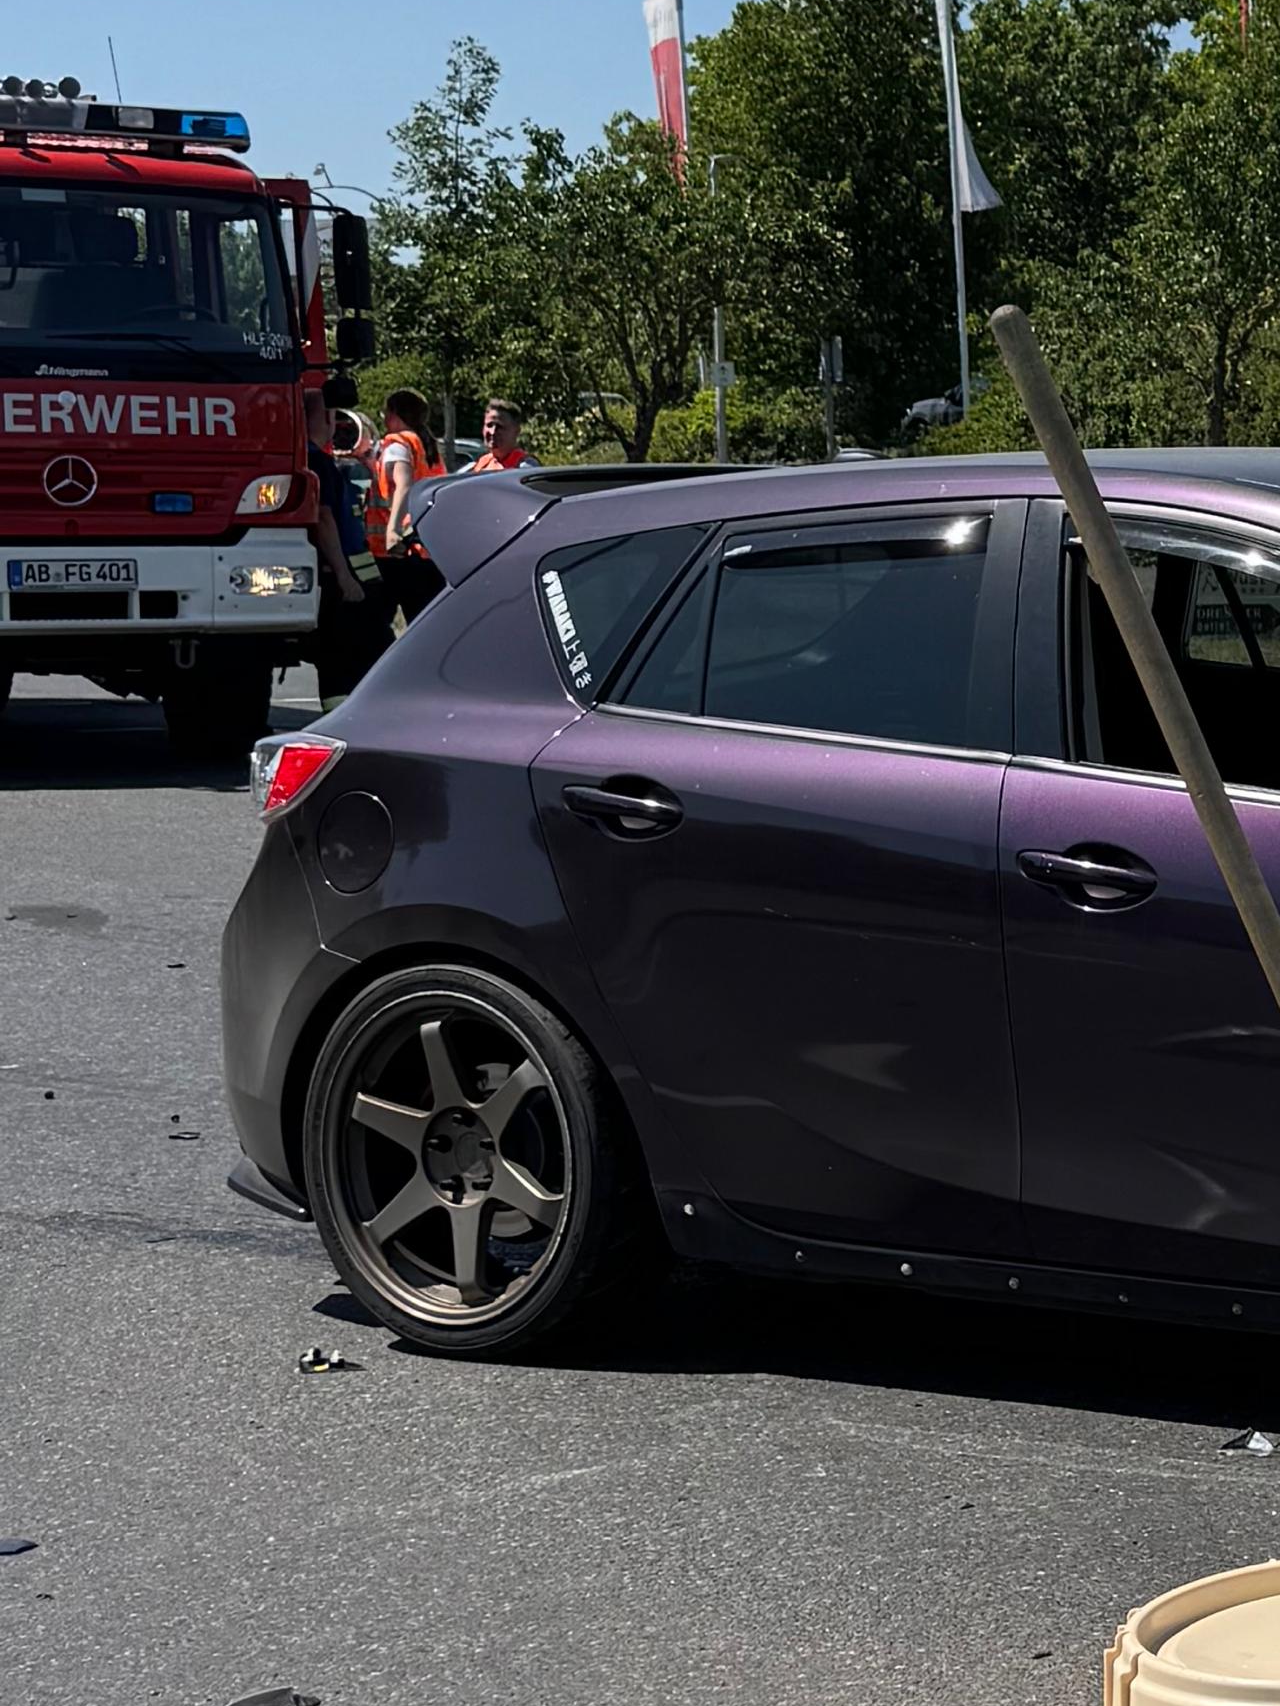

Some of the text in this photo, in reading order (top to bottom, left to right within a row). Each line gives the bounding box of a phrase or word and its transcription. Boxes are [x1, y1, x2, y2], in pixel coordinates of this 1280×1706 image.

[25, 563, 134, 583] AB FG 401
